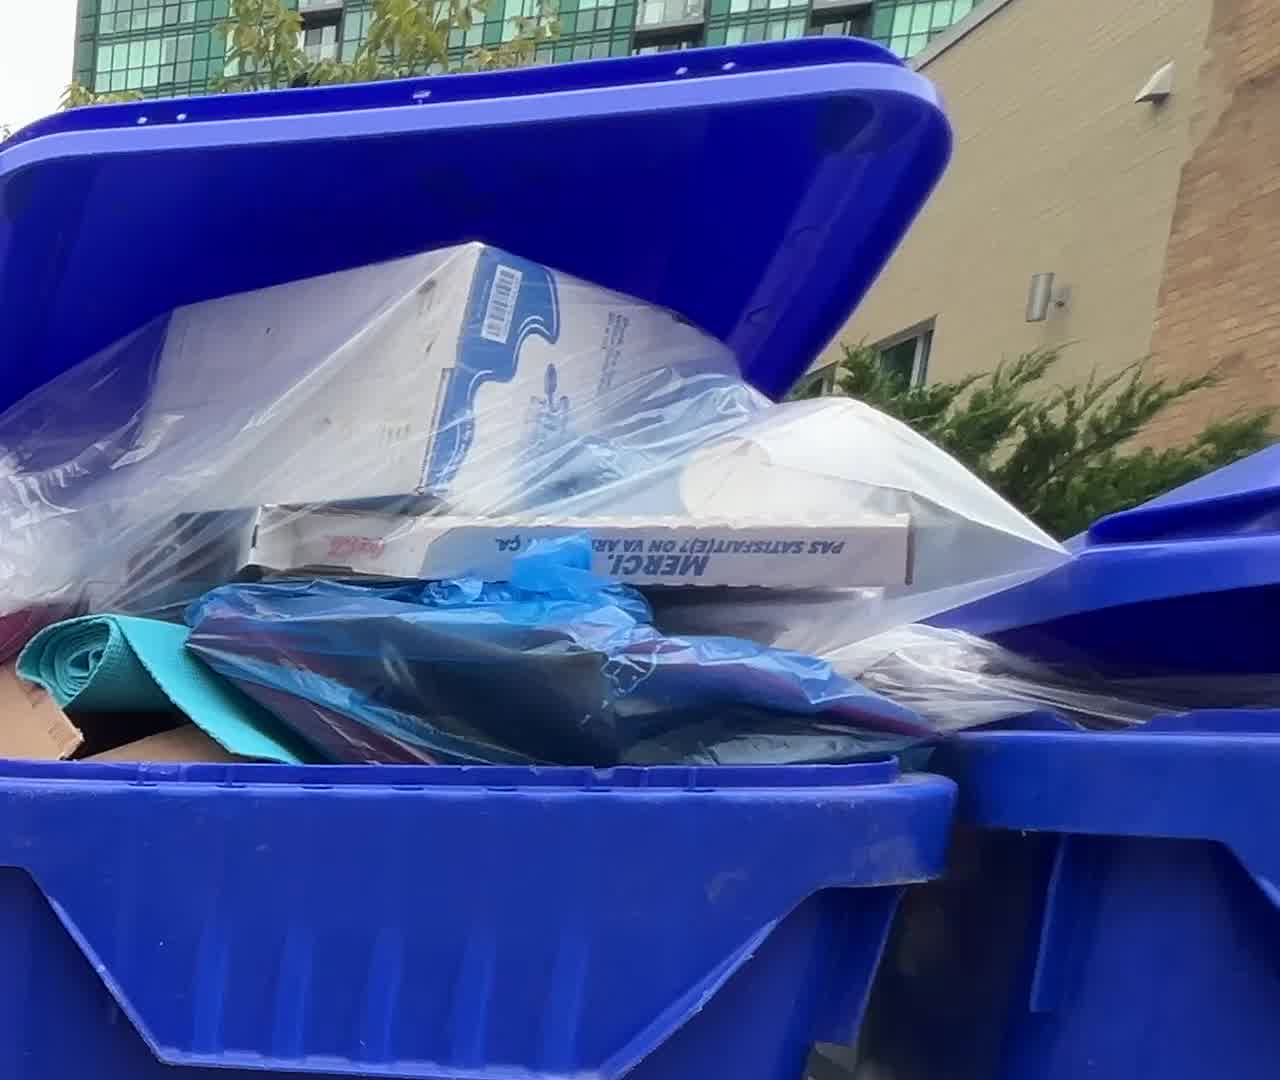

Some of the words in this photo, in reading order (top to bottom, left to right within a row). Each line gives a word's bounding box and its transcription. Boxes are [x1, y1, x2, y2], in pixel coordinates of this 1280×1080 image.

[623, 538, 645, 552] VA
[647, 539, 677, 553] ON
[807, 539, 846, 554] PAS
[608, 554, 711, 577] MERCI.
